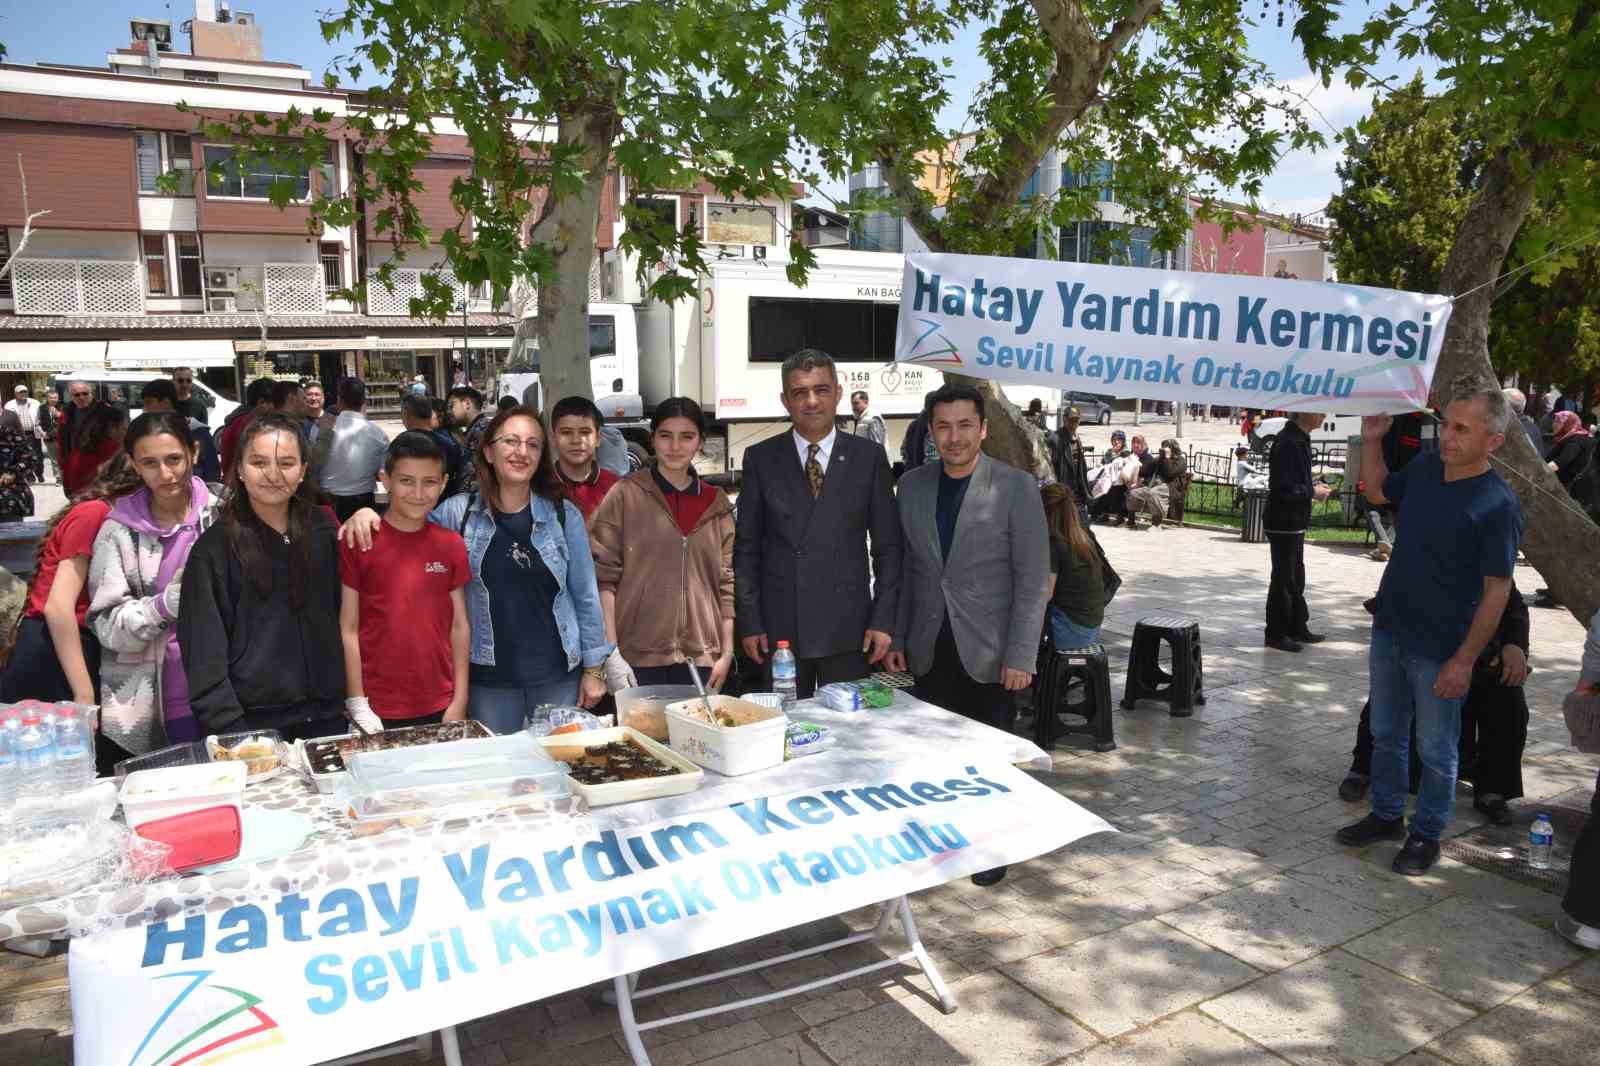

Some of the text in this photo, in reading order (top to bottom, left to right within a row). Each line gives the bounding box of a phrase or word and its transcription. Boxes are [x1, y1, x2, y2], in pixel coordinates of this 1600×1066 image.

[857, 287, 878, 297] KAN
[913, 269, 1433, 361] Hatay Yardım Kermesi
[851, 371, 870, 381] 168
[905, 370, 923, 379] KAN
[976, 336, 1357, 399] Sevil Kaynak Ortaokulu
[141, 766, 1012, 968] Hatay Yardım Kermesi
[304, 814, 971, 1015] Sevil Kaynak Ortaokulu
